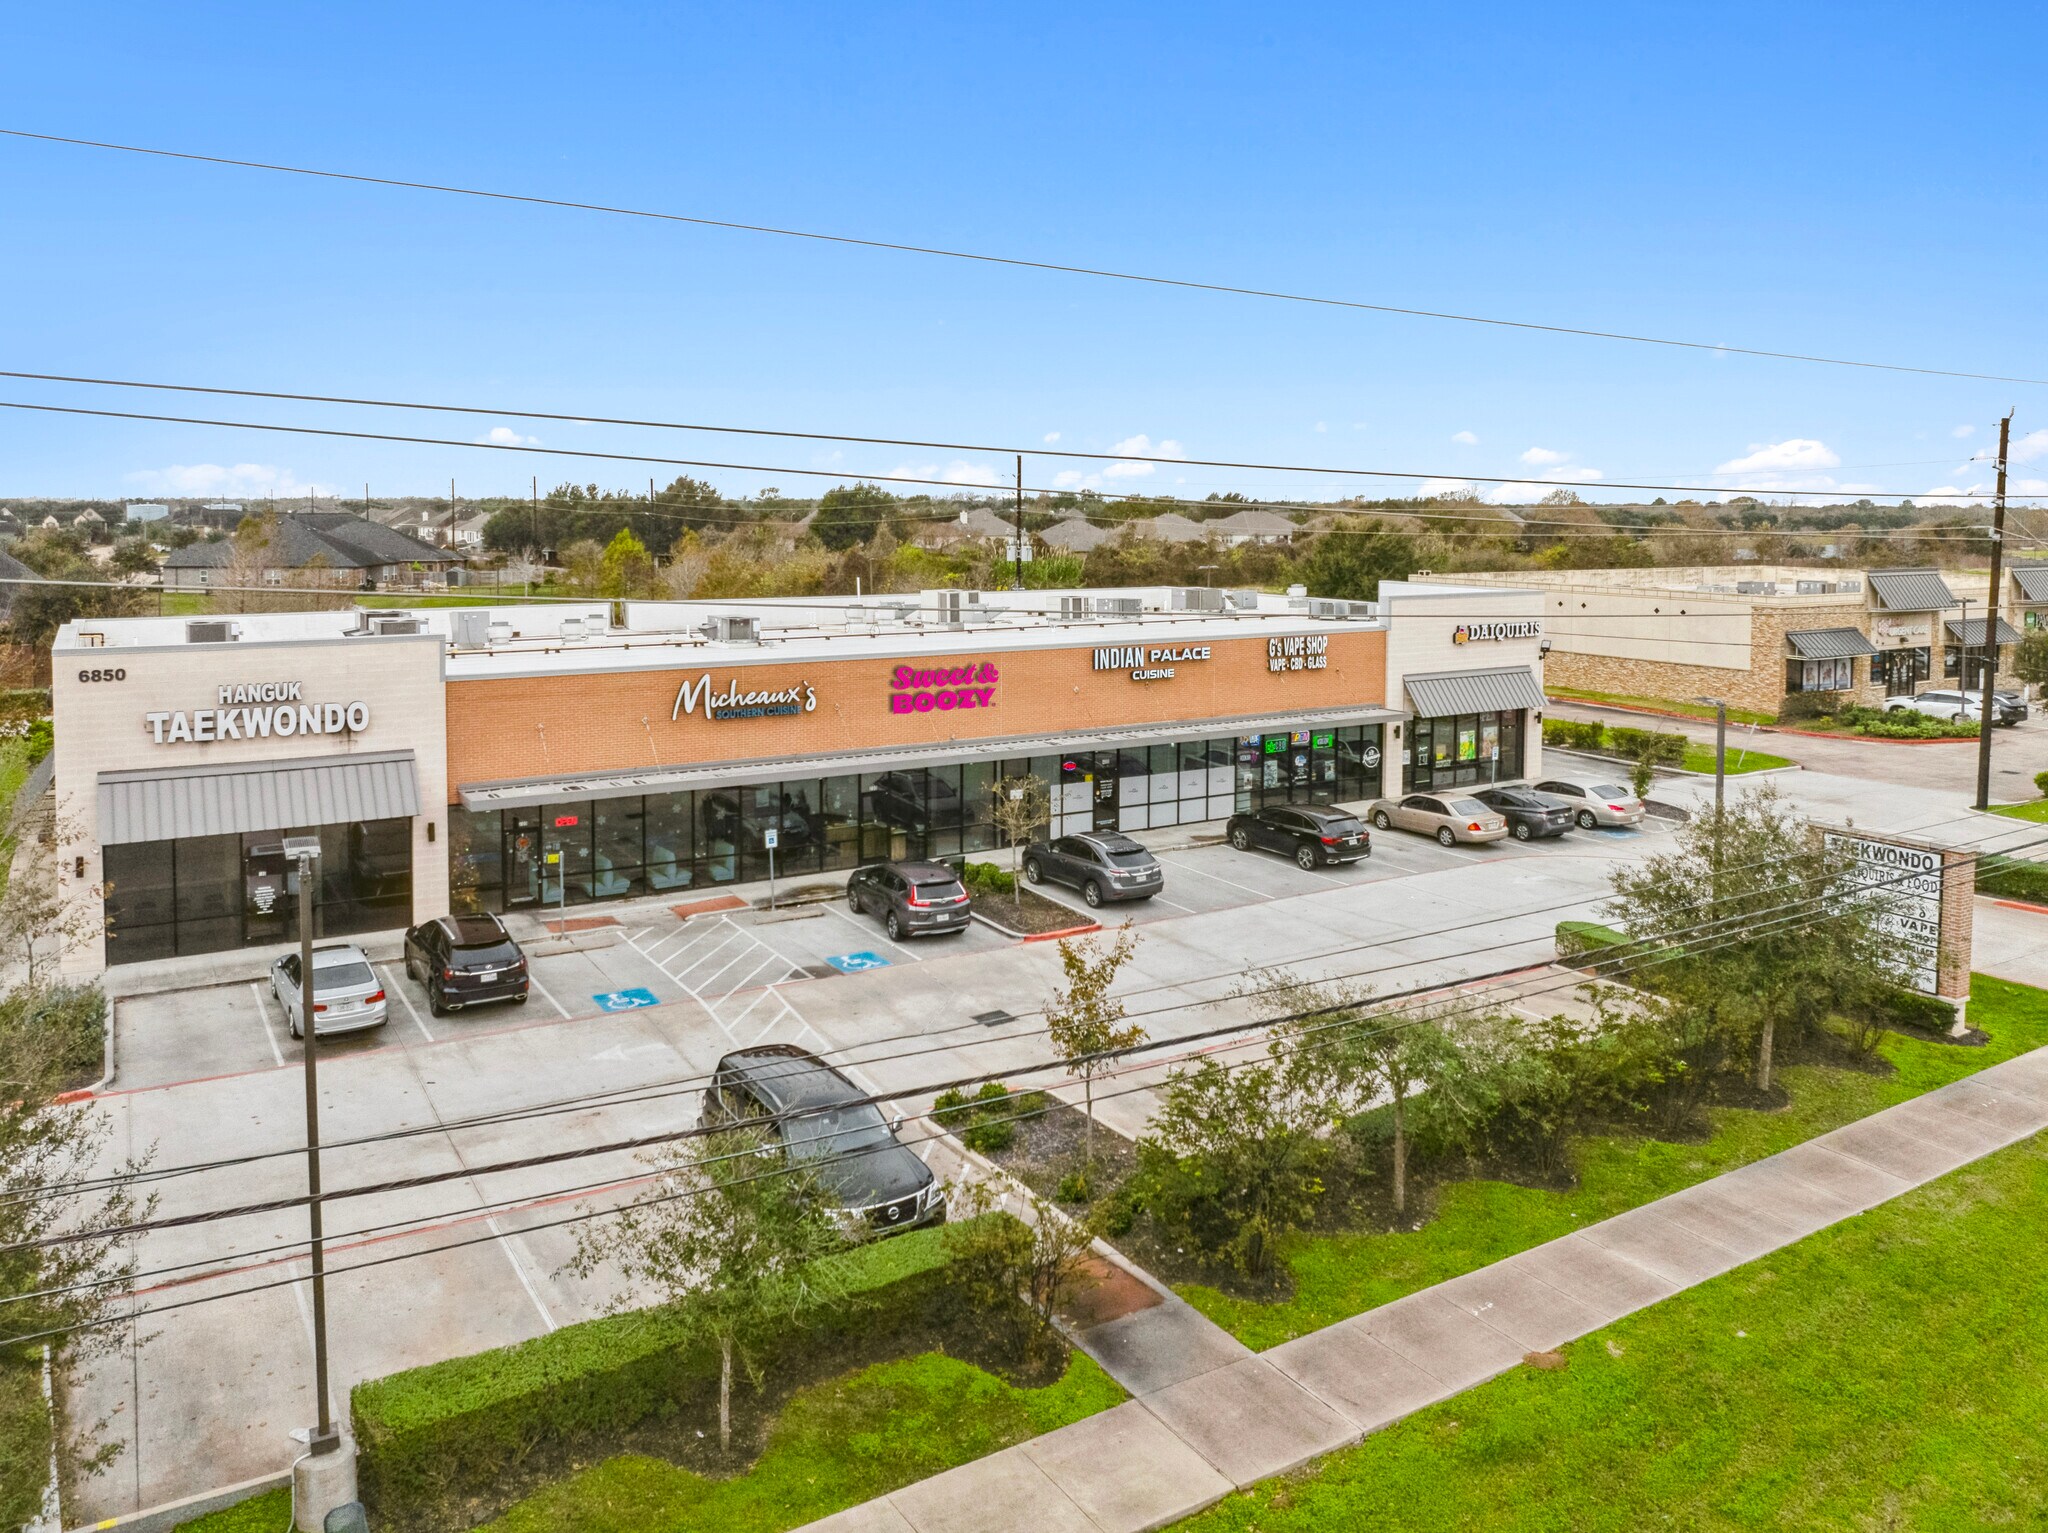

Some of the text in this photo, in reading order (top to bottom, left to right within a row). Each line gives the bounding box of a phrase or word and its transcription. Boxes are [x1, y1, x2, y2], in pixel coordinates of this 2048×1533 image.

[1470, 622, 1541, 641] DAIQUIRIS
[1268, 635, 1328, 657] G's VAPE SHOP
[1094, 646, 1211, 670] INDIAN PALACE
[1269, 658, 1286, 672] VAPE
[1290, 657, 1303, 670] CBD
[1307, 656, 1327, 669] GLASS
[78, 668, 126, 683] 6850
[893, 662, 999, 690] Sweet &
[1132, 668, 1175, 681] CUISINE
[218, 681, 302, 705] HANGUK
[672, 673, 817, 721] Micheaux's
[716, 705, 802, 720] SOUTHERN CUISINE
[146, 700, 370, 744] TAEKWONDO
[555, 816, 578, 827] OPEN
[1900, 918, 1936, 935] VAPE
[1910, 932, 1936, 944] SHOP
